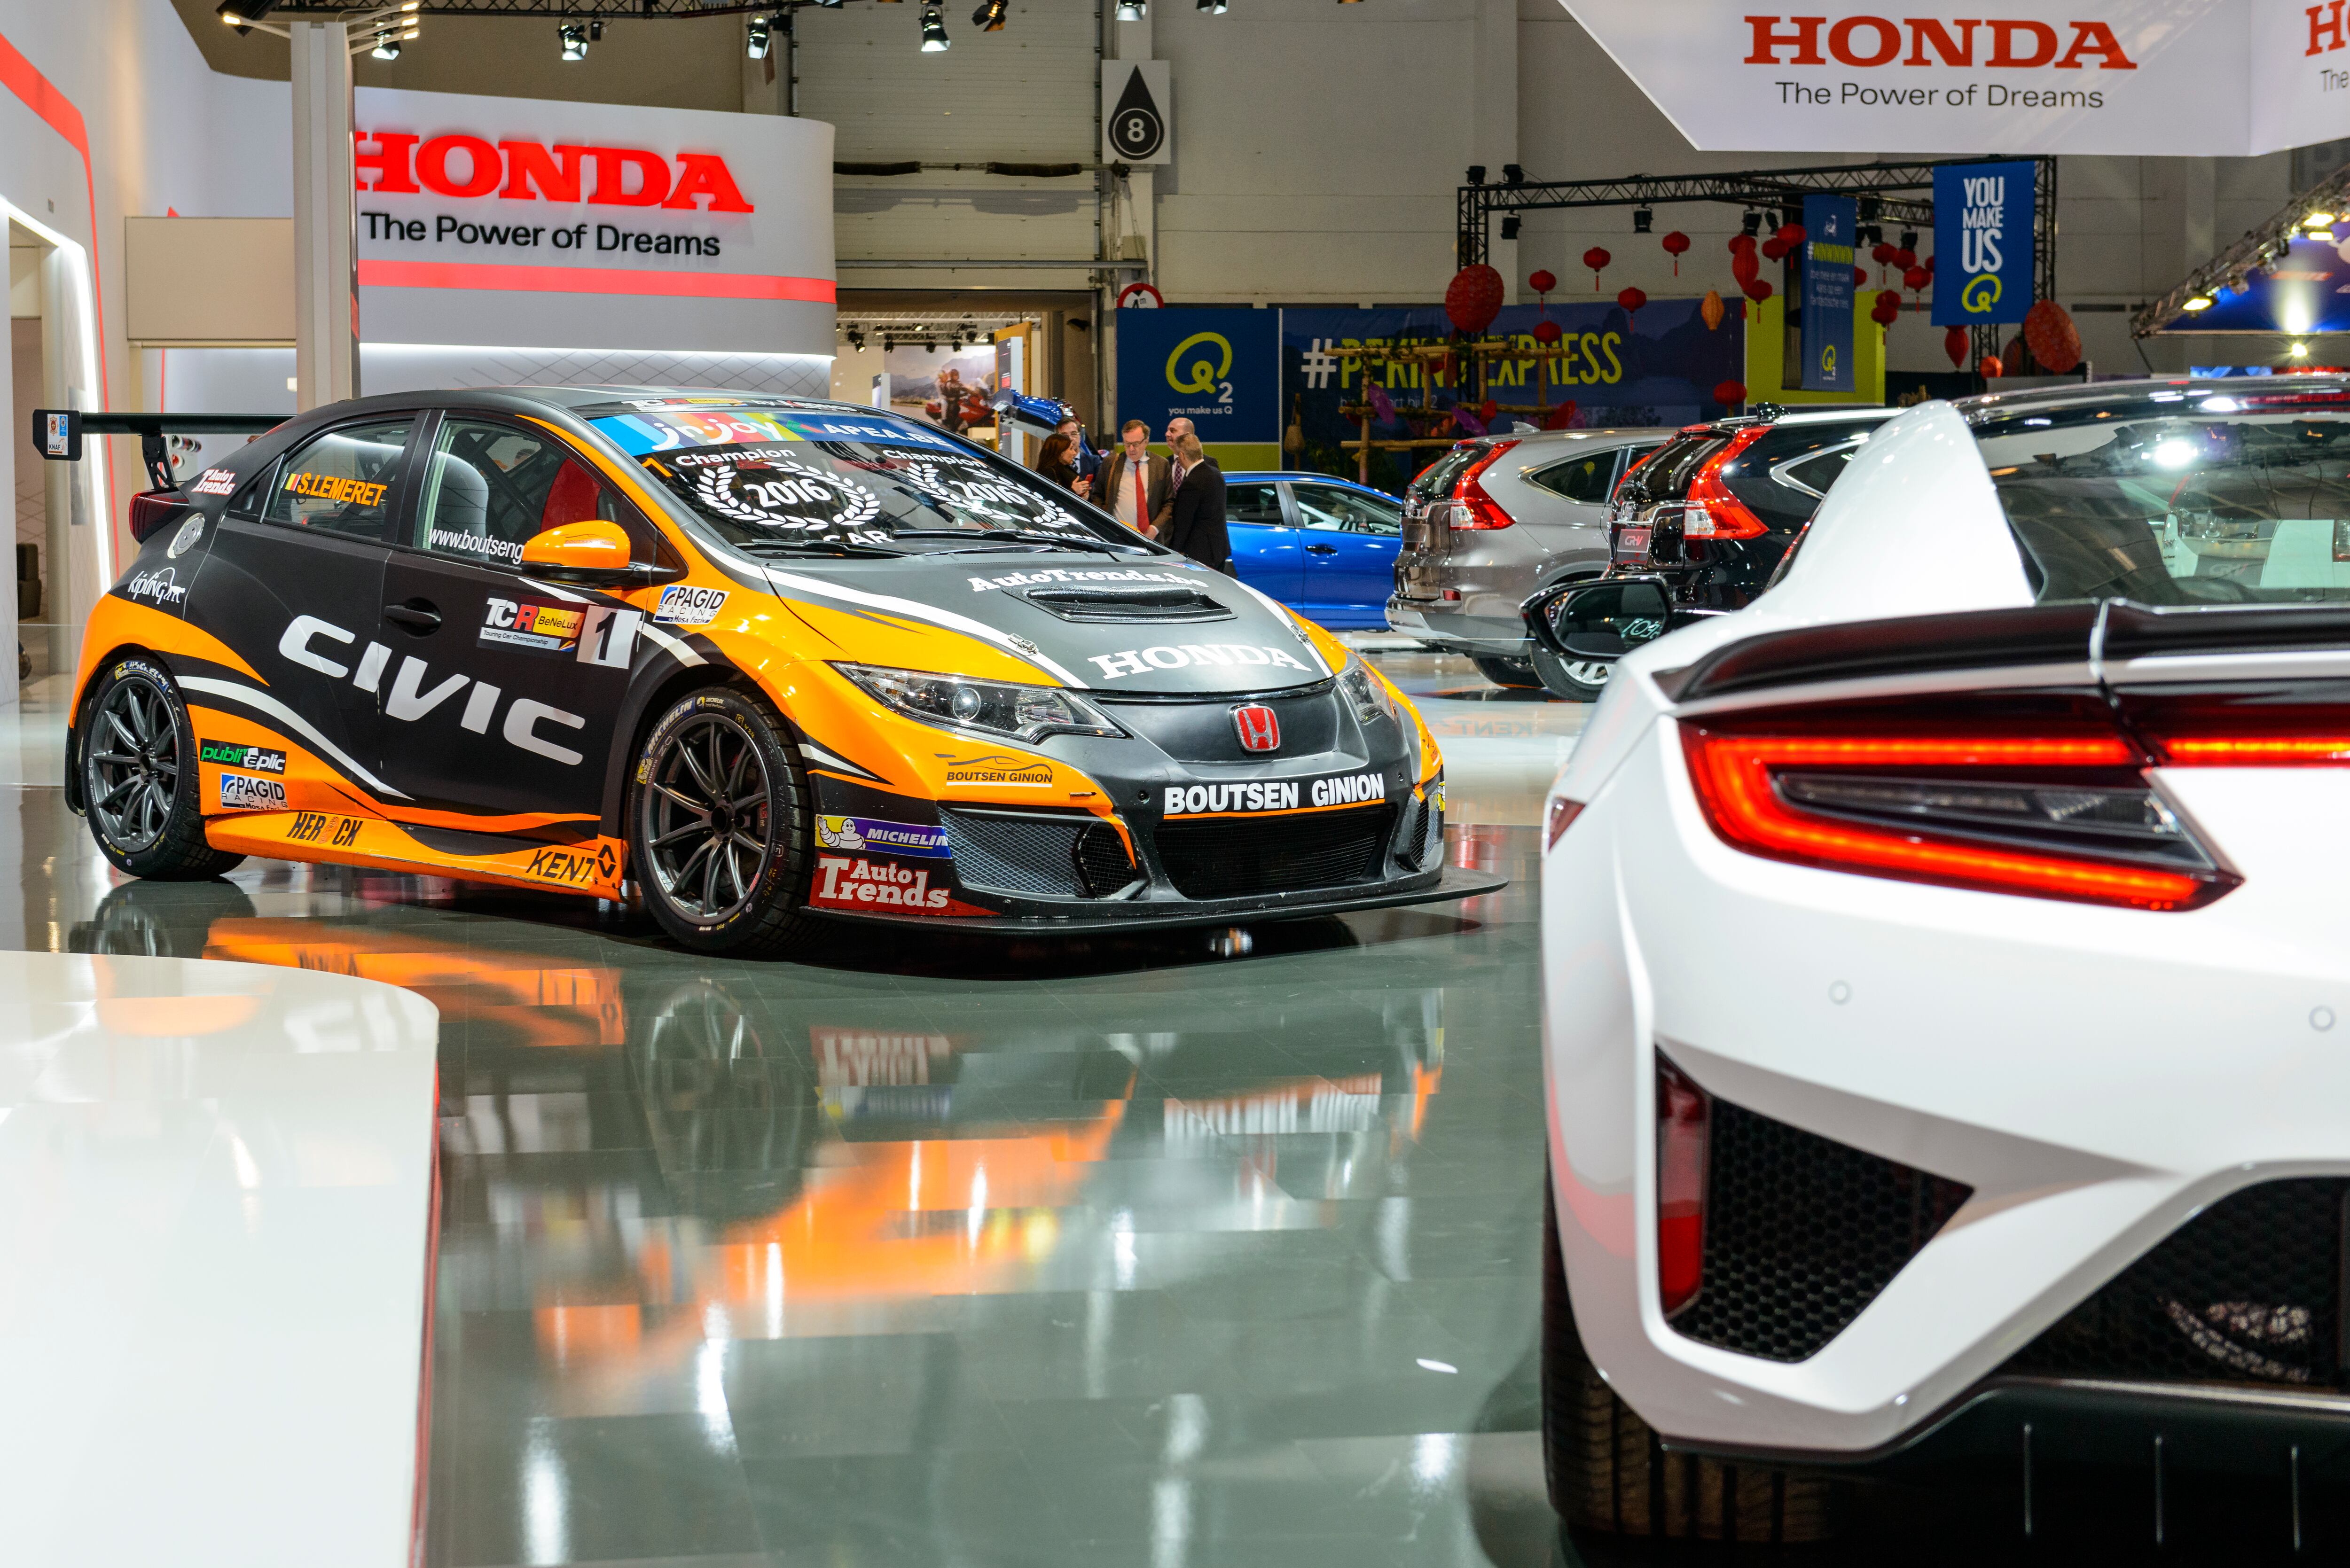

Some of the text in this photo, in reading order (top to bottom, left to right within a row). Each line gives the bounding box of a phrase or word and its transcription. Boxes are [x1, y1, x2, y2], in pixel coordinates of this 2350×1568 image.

[1744, 16, 2137, 70] HONDA
[1776, 81, 2103, 109] The Power of Dreams
[1127, 118, 1145, 142] 8
[356, 131, 754, 213] HONDA
[1963, 176, 2005, 208] YOU
[1962, 206, 2004, 229] MAKE
[361, 212, 720, 256] The Power of Dreams
[1962, 228, 2003, 273] US
[1168, 407, 1185, 416] you
[1224, 406, 1233, 414] Q
[823, 424, 954, 447] APEA.BE
[675, 449, 797, 466] Champion
[882, 450, 988, 468] Champion
[191, 469, 236, 495] Trends
[208, 470, 227, 482] Auto
[297, 472, 387, 507] S.LEMERET
[743, 478, 831, 508] 2016
[948, 481, 1028, 506] 2016
[429, 529, 524, 564] www.boutseng
[967, 569, 1209, 592] AutoTrends.be
[658, 605, 717, 616] RACING
[674, 587, 726, 609] PAGID
[486, 597, 579, 632] TCR BeNeLux
[484, 630, 501, 639] Touring
[513, 634, 548, 645] Championship
[595, 612, 617, 661] 1
[1087, 644, 1312, 679] HONDA
[278, 615, 585, 765] CIVIC
[237, 776, 285, 800] PAGID
[947, 772, 1053, 783] BOUTSEN GINION
[221, 793, 288, 808] RACING
[1164, 773, 1385, 814] BOUTSEN GINION
[867, 828, 948, 846] MICHELIN
[525, 850, 595, 882] KENT
[850, 860, 912, 884] Auto
[819, 858, 949, 908] Trends
